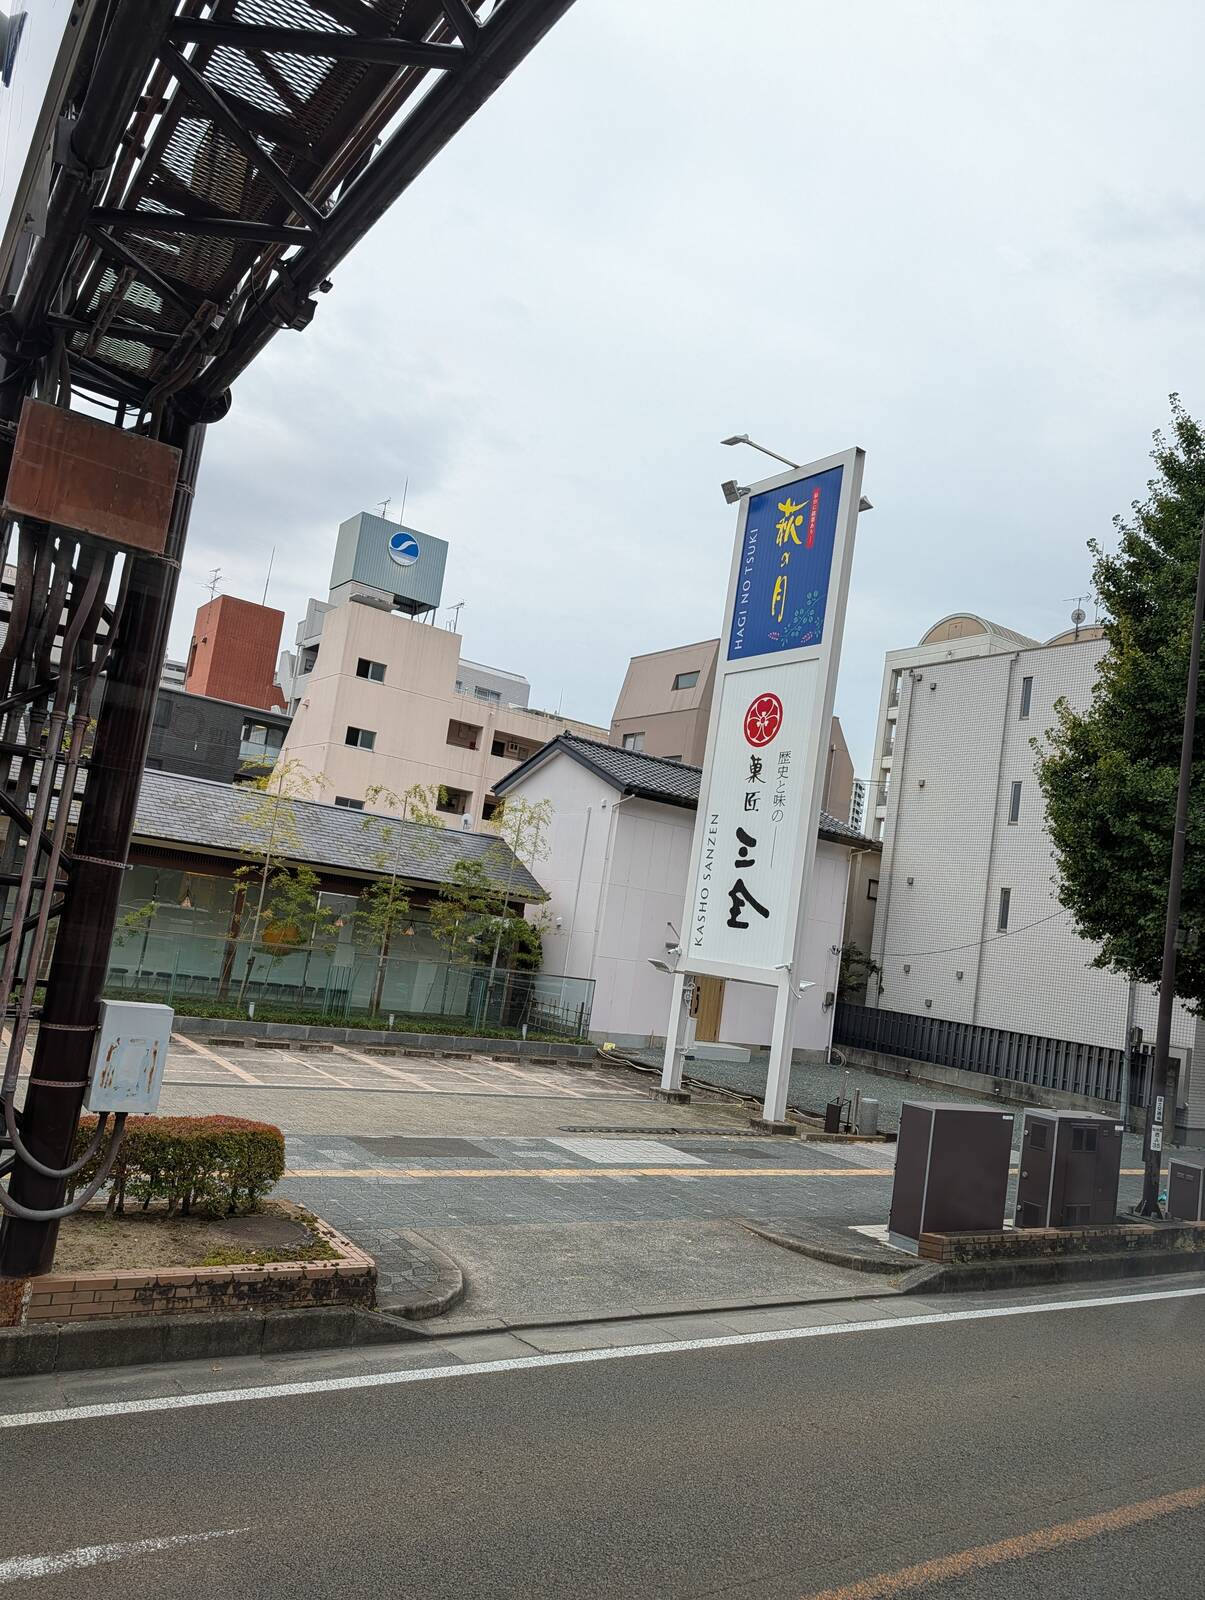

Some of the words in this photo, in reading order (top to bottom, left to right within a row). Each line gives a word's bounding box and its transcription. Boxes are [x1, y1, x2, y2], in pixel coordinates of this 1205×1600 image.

[744, 528, 759, 572] TSUKI
[771, 497, 809, 623] 萩の月
[741, 580, 751, 604] NO
[734, 610, 747, 650] HAGI
[694, 887, 710, 947] KASHO
[702, 814, 719, 881] SANZEN
